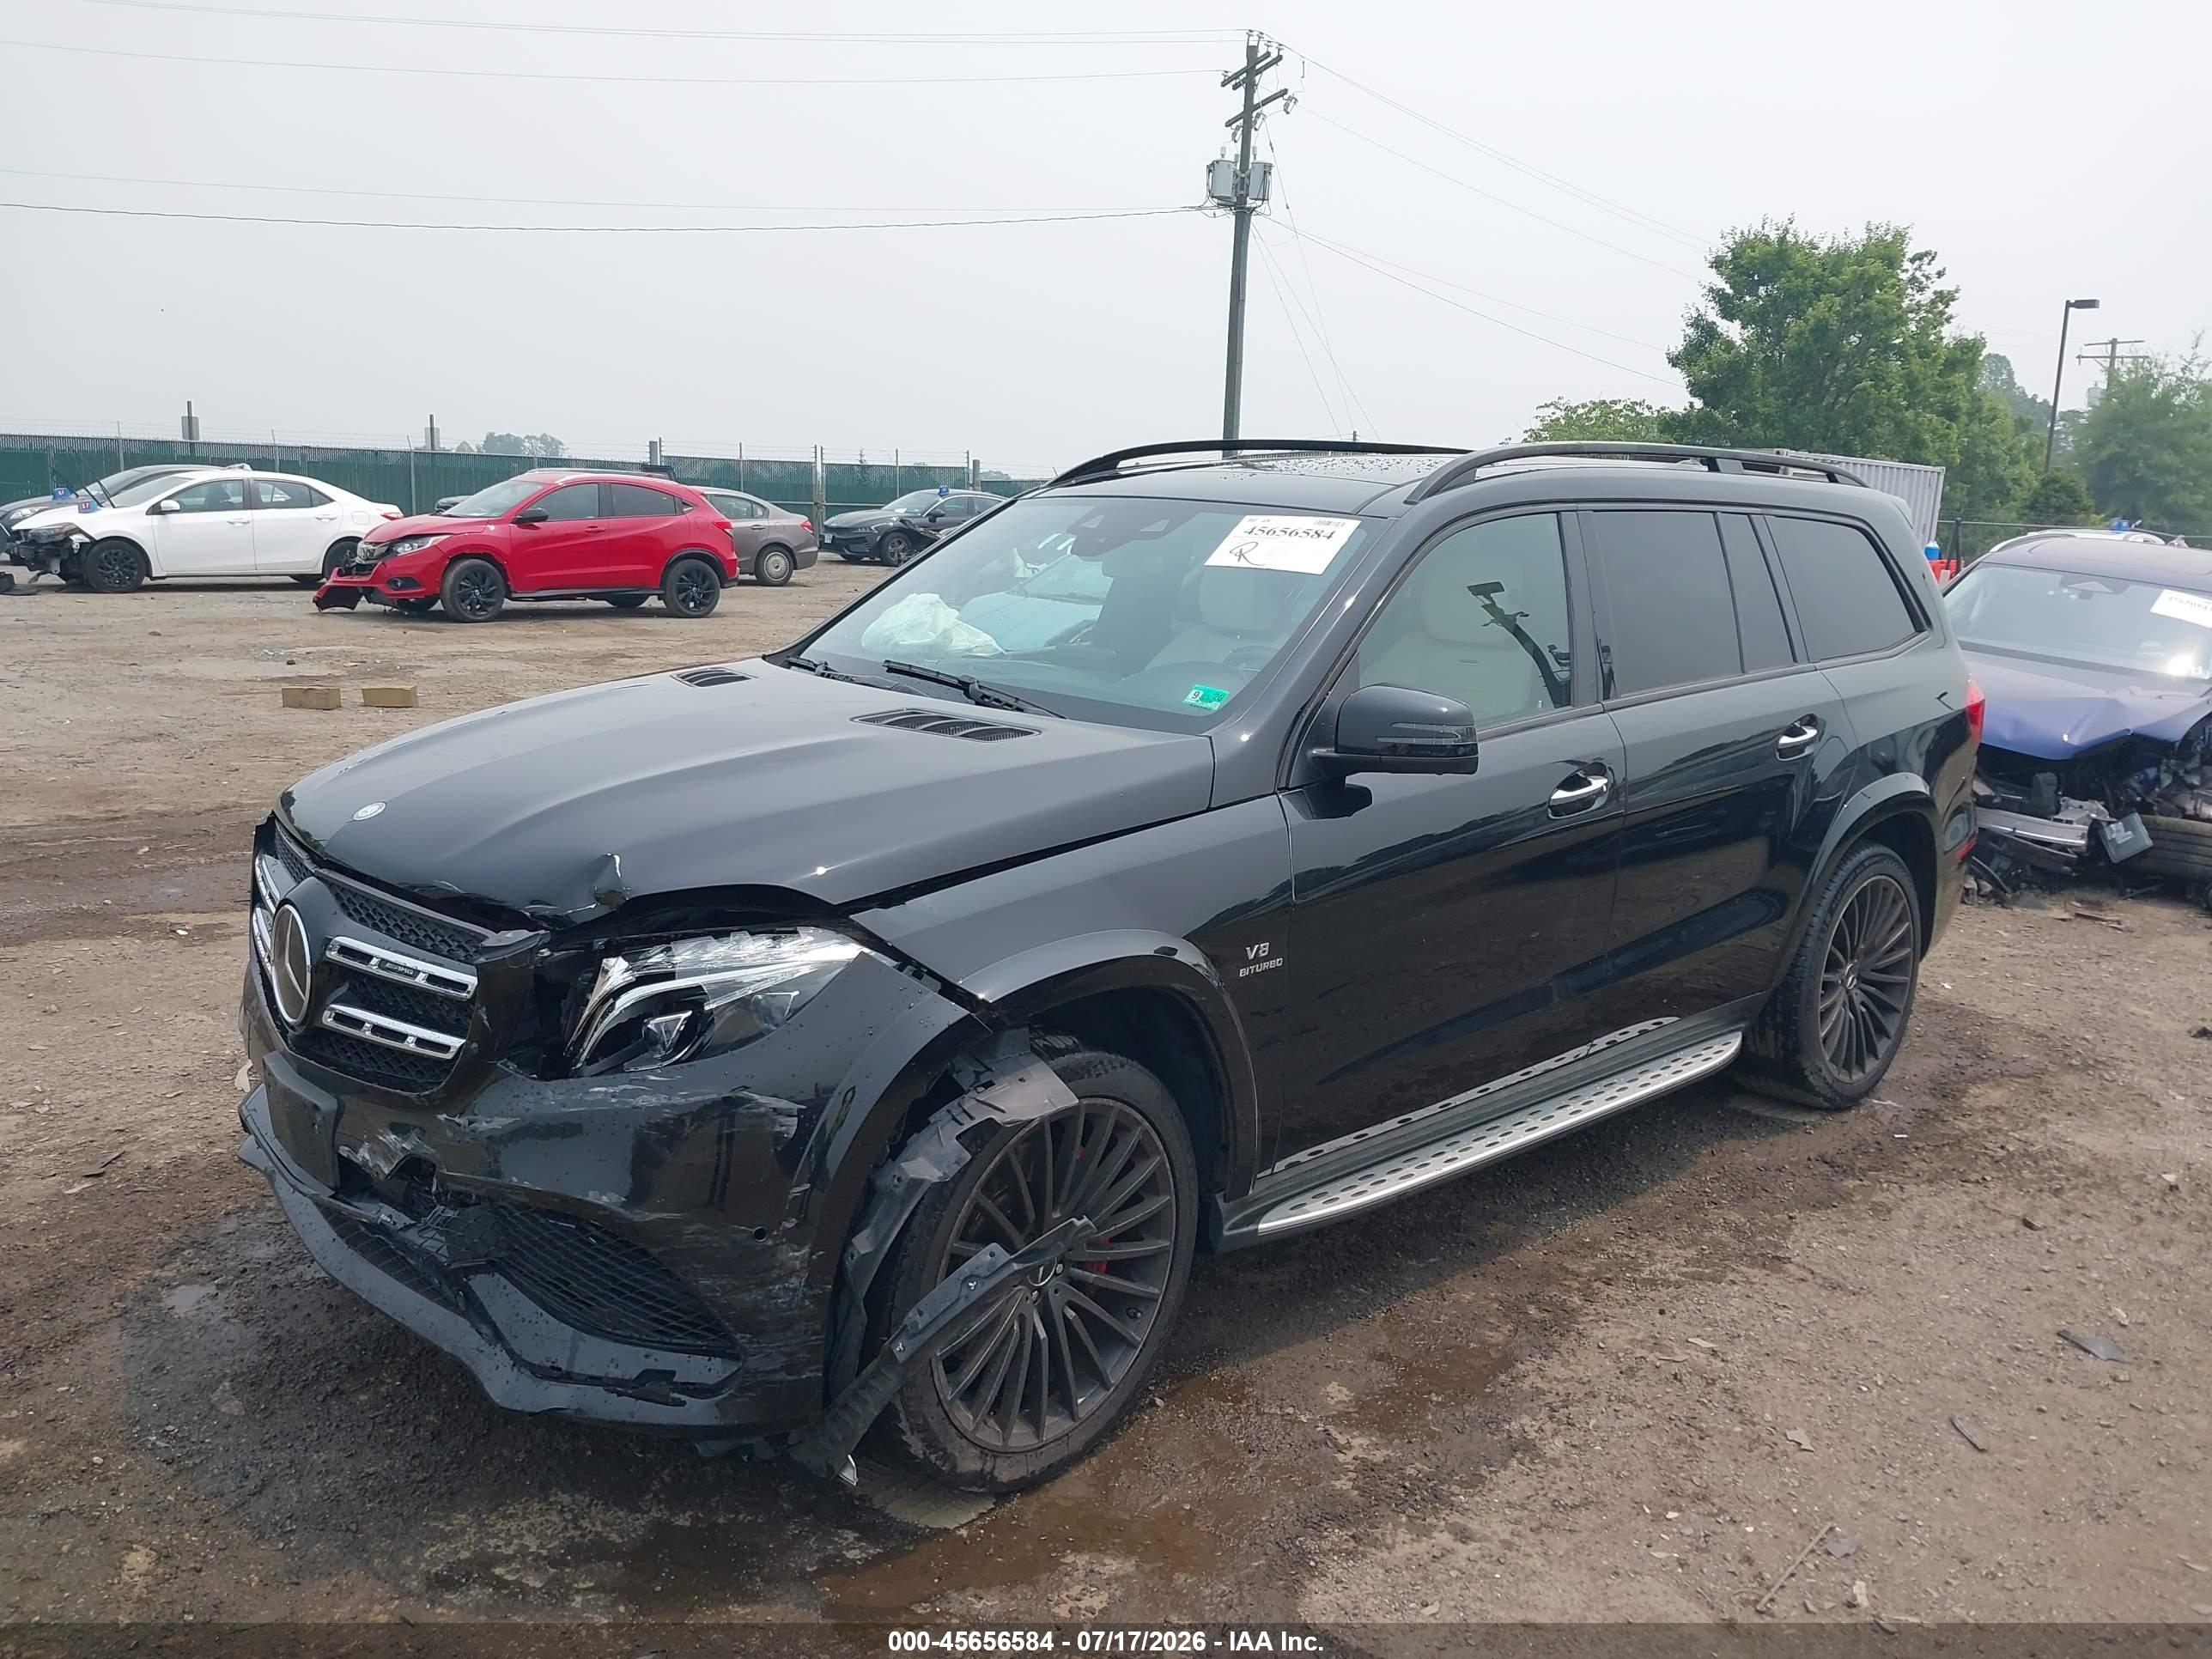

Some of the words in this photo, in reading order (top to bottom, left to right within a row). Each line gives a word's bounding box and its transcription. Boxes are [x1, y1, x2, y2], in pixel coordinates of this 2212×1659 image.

[1243, 526, 1336, 540] 45656584
[1245, 942, 1270, 960] V8
[1239, 957, 1284, 977] BITURBO
